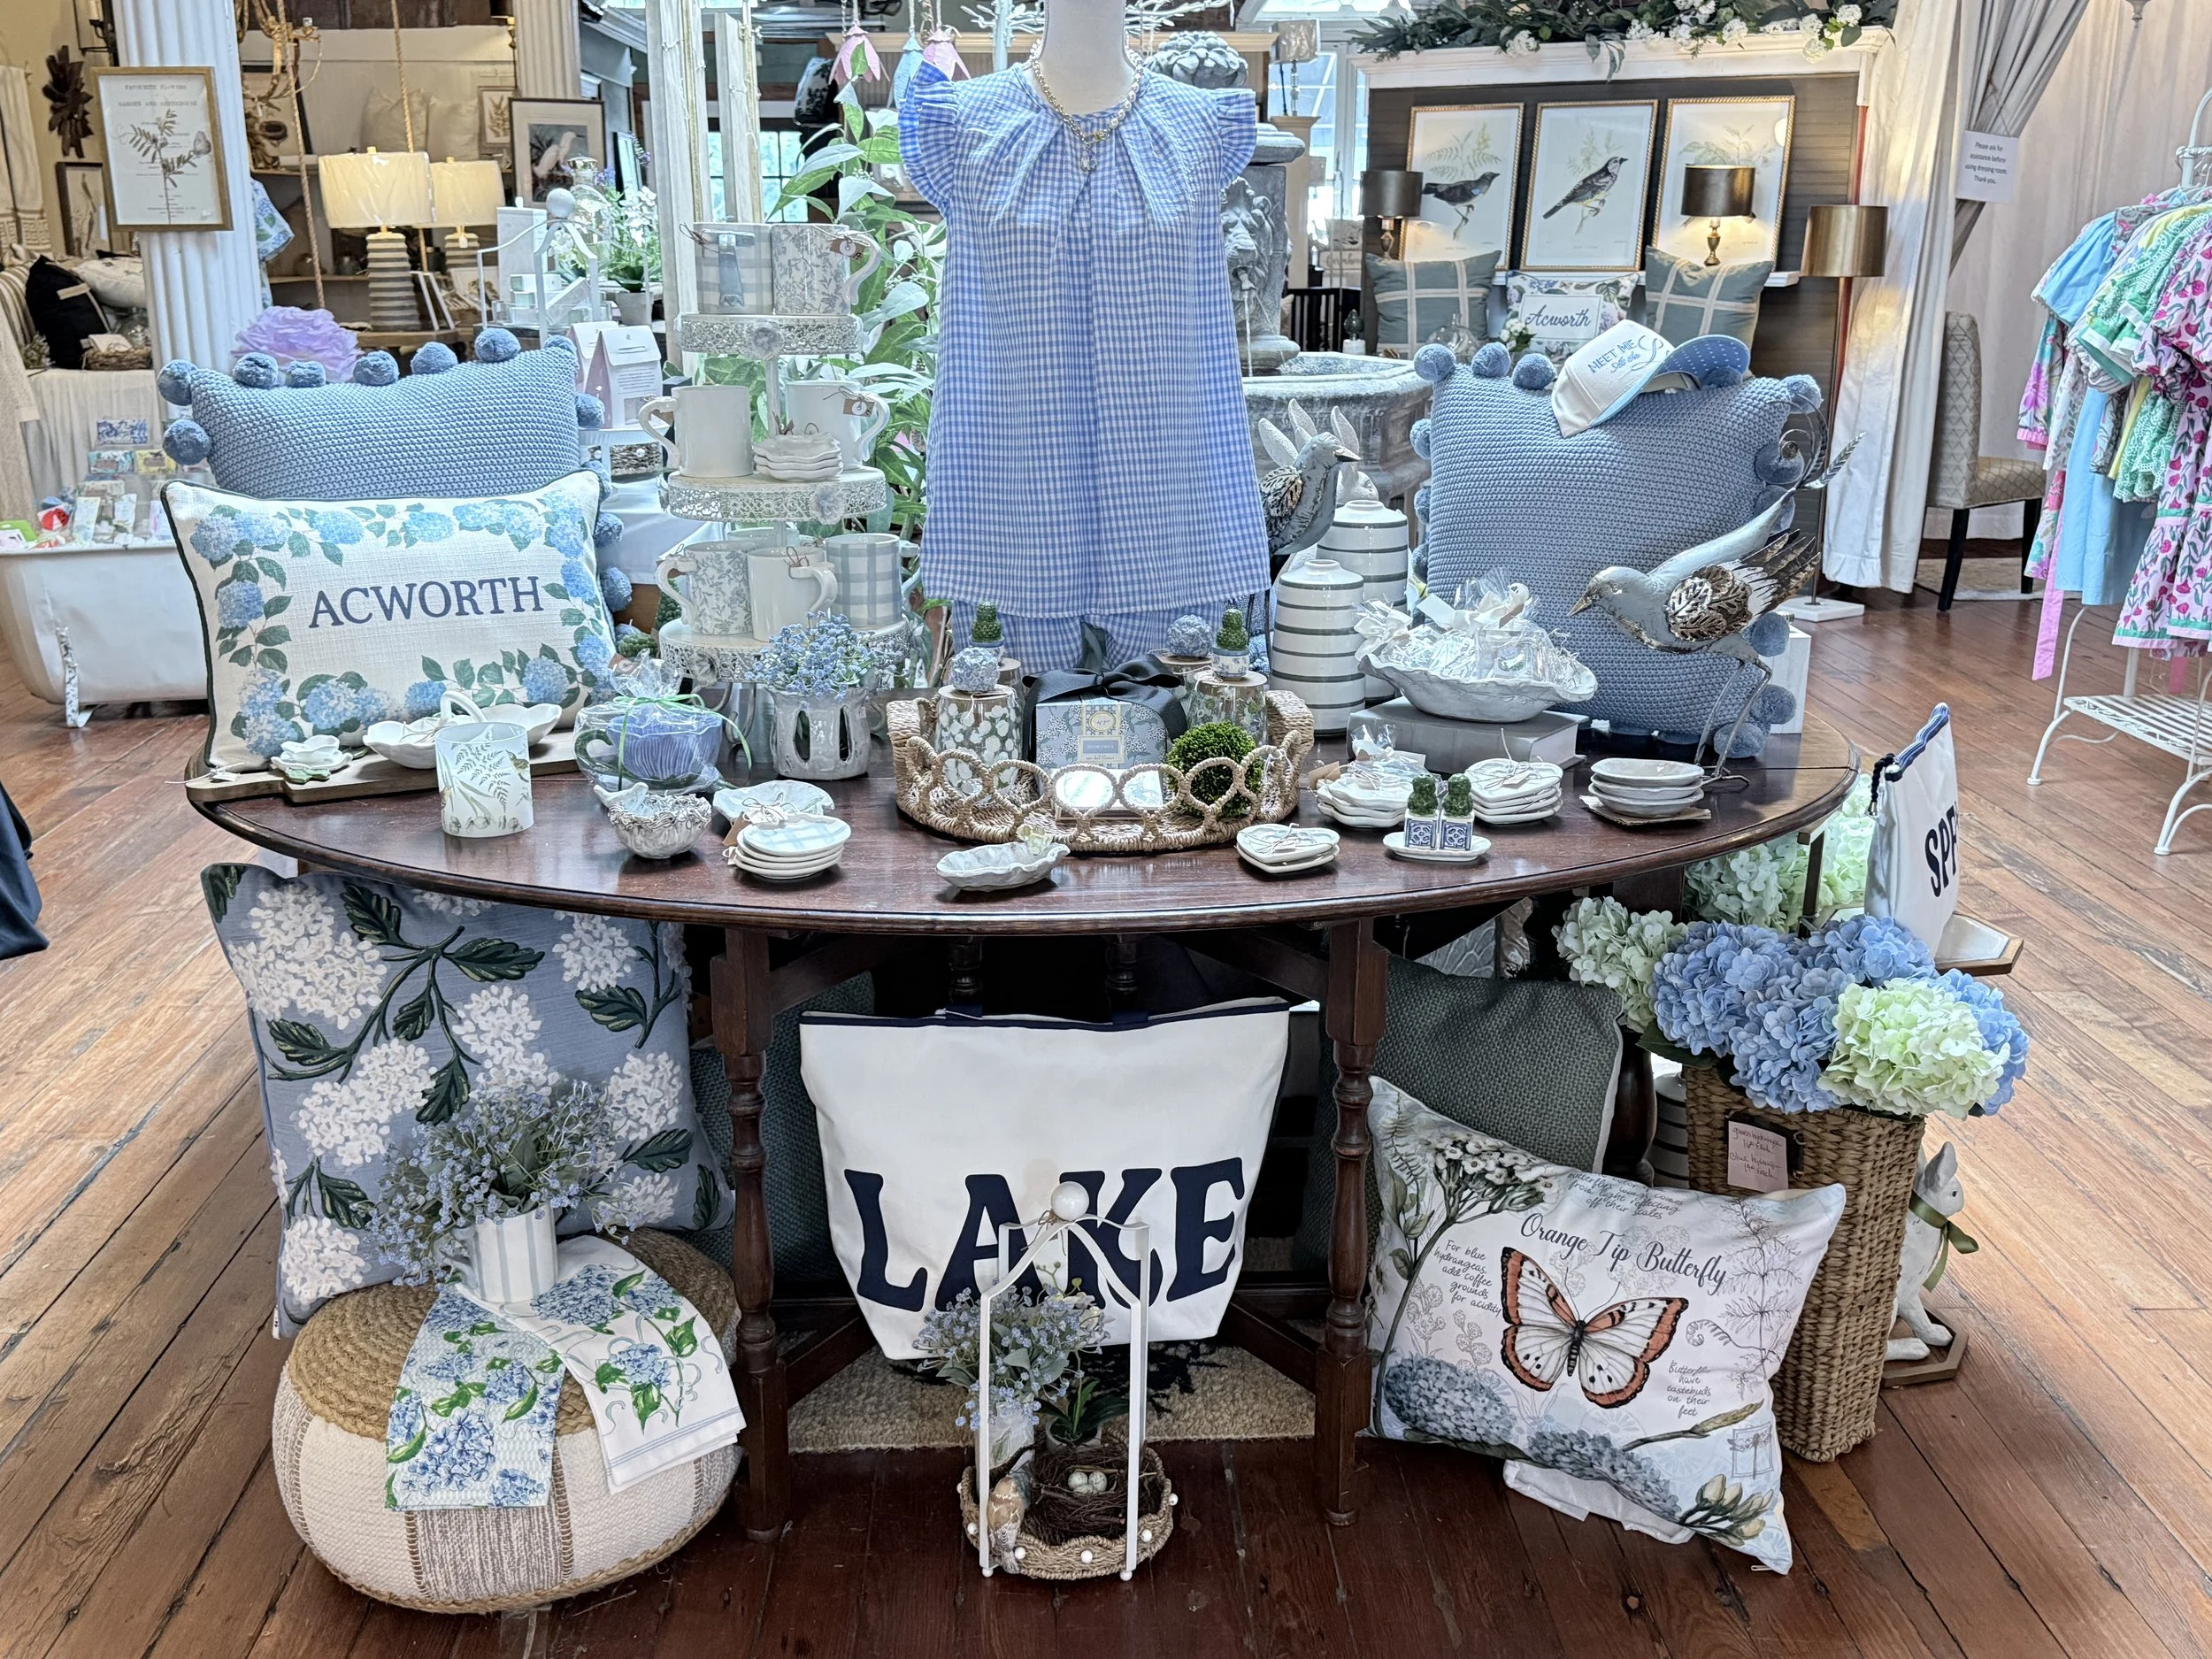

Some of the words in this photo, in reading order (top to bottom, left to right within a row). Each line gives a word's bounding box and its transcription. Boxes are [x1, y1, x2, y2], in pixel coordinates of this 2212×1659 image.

[1525, 304, 1592, 327] Acworth
[1587, 349, 1617, 373] MEET
[1617, 339, 1637, 353] ME
[309, 576, 544, 628] ACWORTH
[1568, 1179, 1593, 1194] from
[1599, 1188, 1625, 1202] light
[1586, 1197, 1602, 1208] off
[1605, 1199, 1629, 1212] their
[1632, 1208, 1663, 1219] scales
[844, 1157, 1245, 1312] LAKE
[1445, 1240, 1462, 1252] For
[1465, 1246, 1486, 1260] blue
[1521, 1212, 1587, 1260] Orange
[1594, 1230, 1632, 1271] Tip
[1637, 1241, 1726, 1295] Butterfly
[1442, 1265, 1461, 1277] add
[1464, 1273, 1493, 1287] coffee
[1450, 1281, 1488, 1299] grounds
[1451, 1291, 1466, 1304] for
[1471, 1300, 1502, 1317] acidity
[1678, 1374, 1701, 1384] have
[1667, 1386, 1711, 1397] tastebuds
[1686, 1394, 1709, 1405] their
[1678, 1404, 1698, 1419] feet
